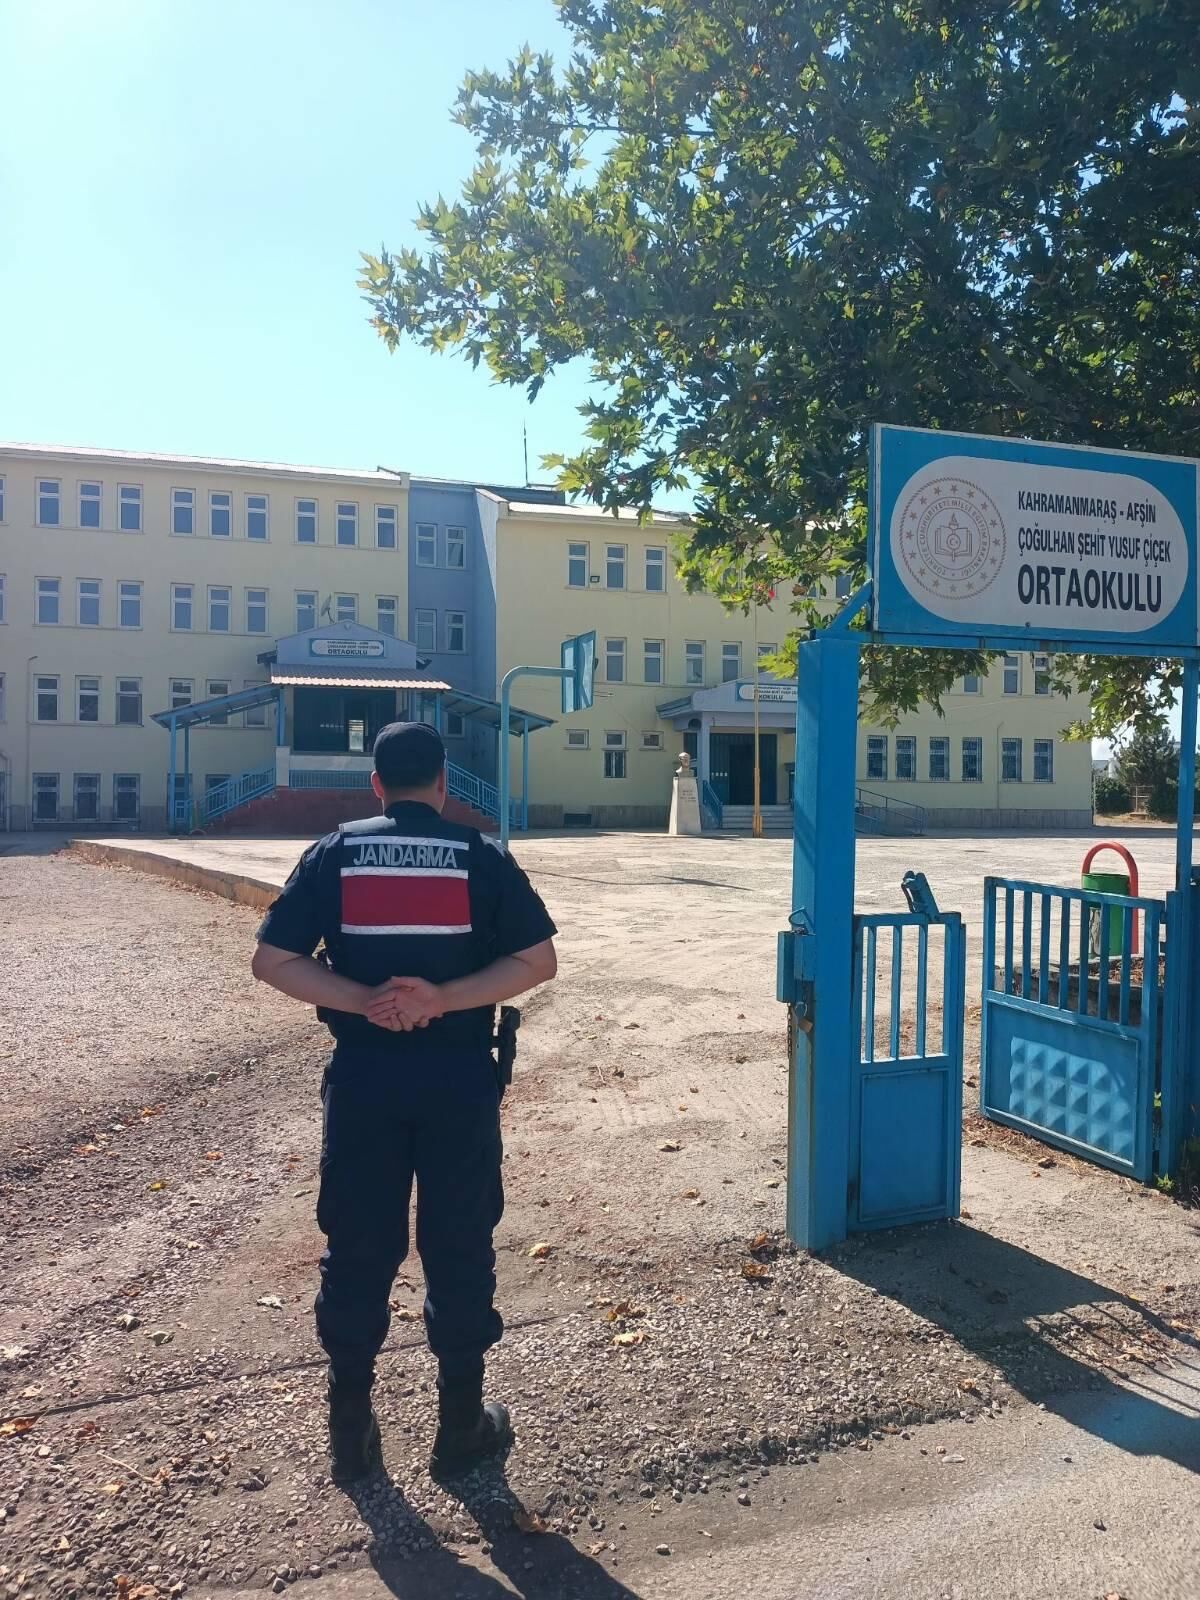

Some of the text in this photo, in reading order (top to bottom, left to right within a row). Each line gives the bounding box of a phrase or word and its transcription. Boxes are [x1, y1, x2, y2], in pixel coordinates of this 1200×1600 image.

[1018, 490, 1117, 524] KAHRAMANMARAŞ
[1126, 498, 1156, 528] AFŞİN
[1018, 522, 1171, 568] ÇOĞULHAN ŞEHİT YUSUF ÇİÇEK
[1017, 564, 1162, 613] ORTAOKULU
[353, 843, 458, 868] JANDARMA
